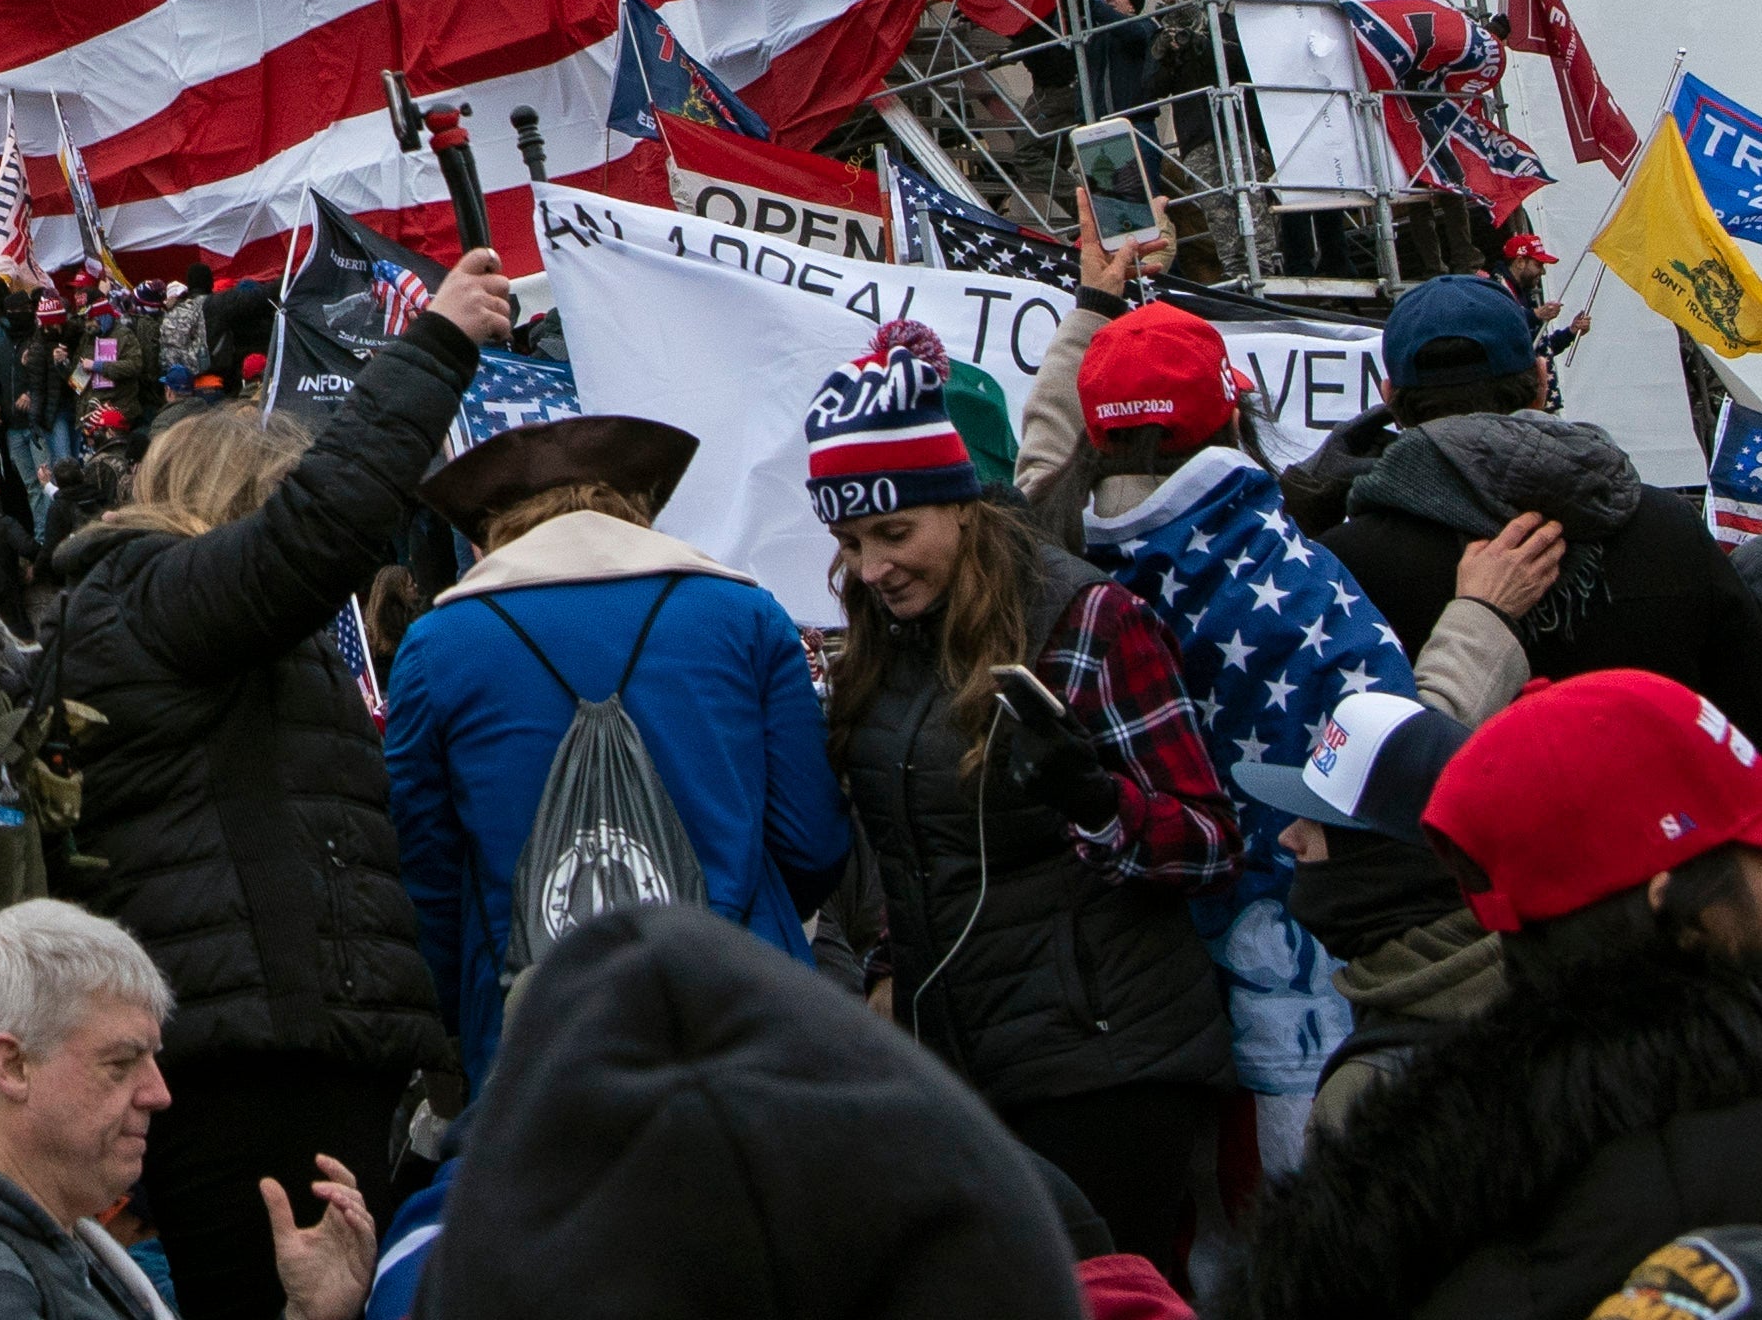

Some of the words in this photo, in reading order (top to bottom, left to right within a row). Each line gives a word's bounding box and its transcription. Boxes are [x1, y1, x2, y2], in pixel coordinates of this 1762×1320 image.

[695, 186, 888, 262] OPEN
[1651, 266, 1687, 298] DONT
[964, 287, 1062, 376] TO
[1095, 398, 1174, 420] TRUMP2020
